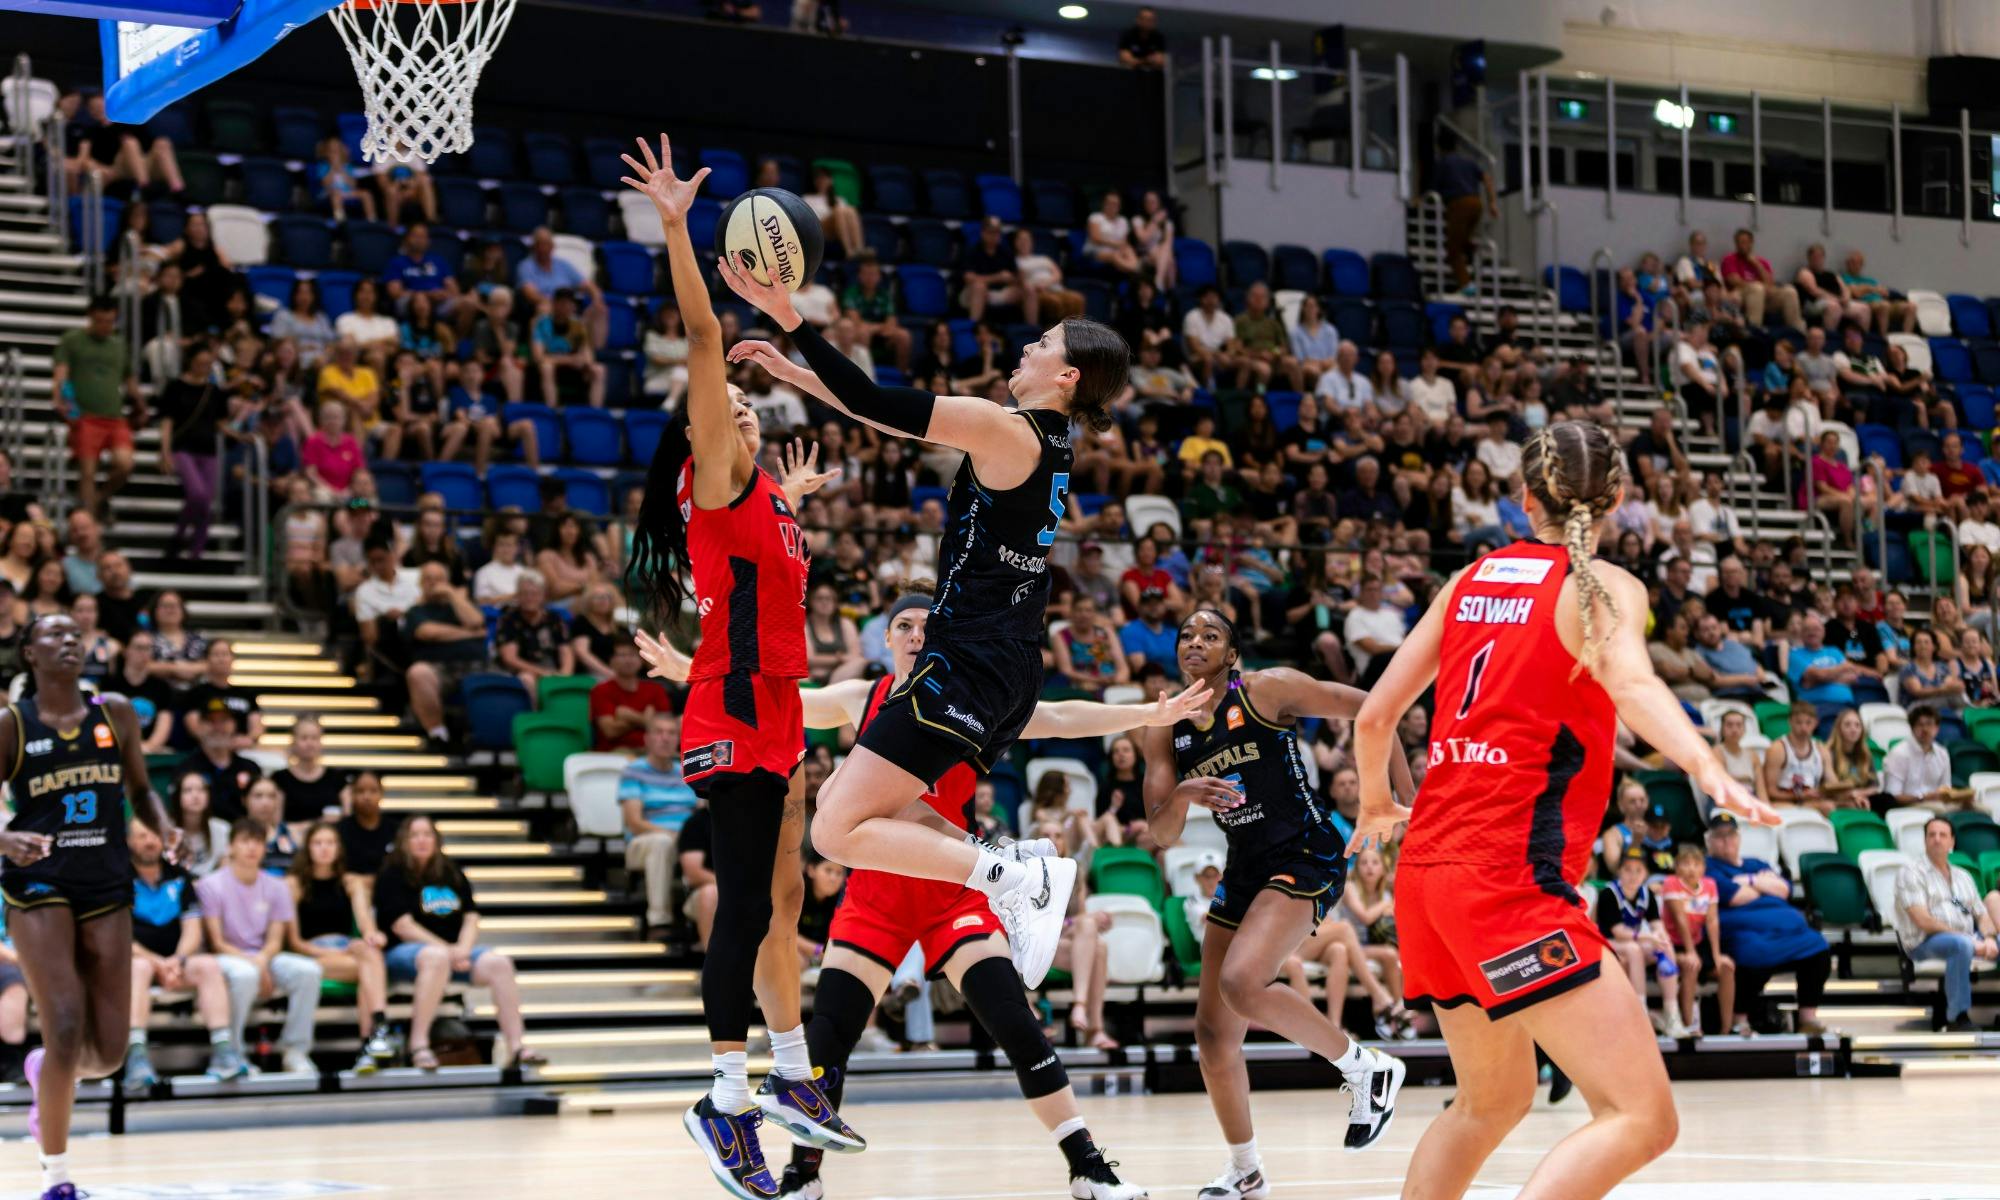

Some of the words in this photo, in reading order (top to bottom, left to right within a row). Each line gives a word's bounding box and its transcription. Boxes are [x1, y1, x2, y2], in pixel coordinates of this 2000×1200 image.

[760, 215, 796, 284] SPALDING
[1036, 472, 1069, 546] 5
[1455, 595, 1535, 625] SOWAH
[1455, 639, 1496, 720] 1
[28, 764, 122, 798] CAPITALS
[61, 790, 97, 824] 13
[1519, 962, 1543, 978] LIVE
